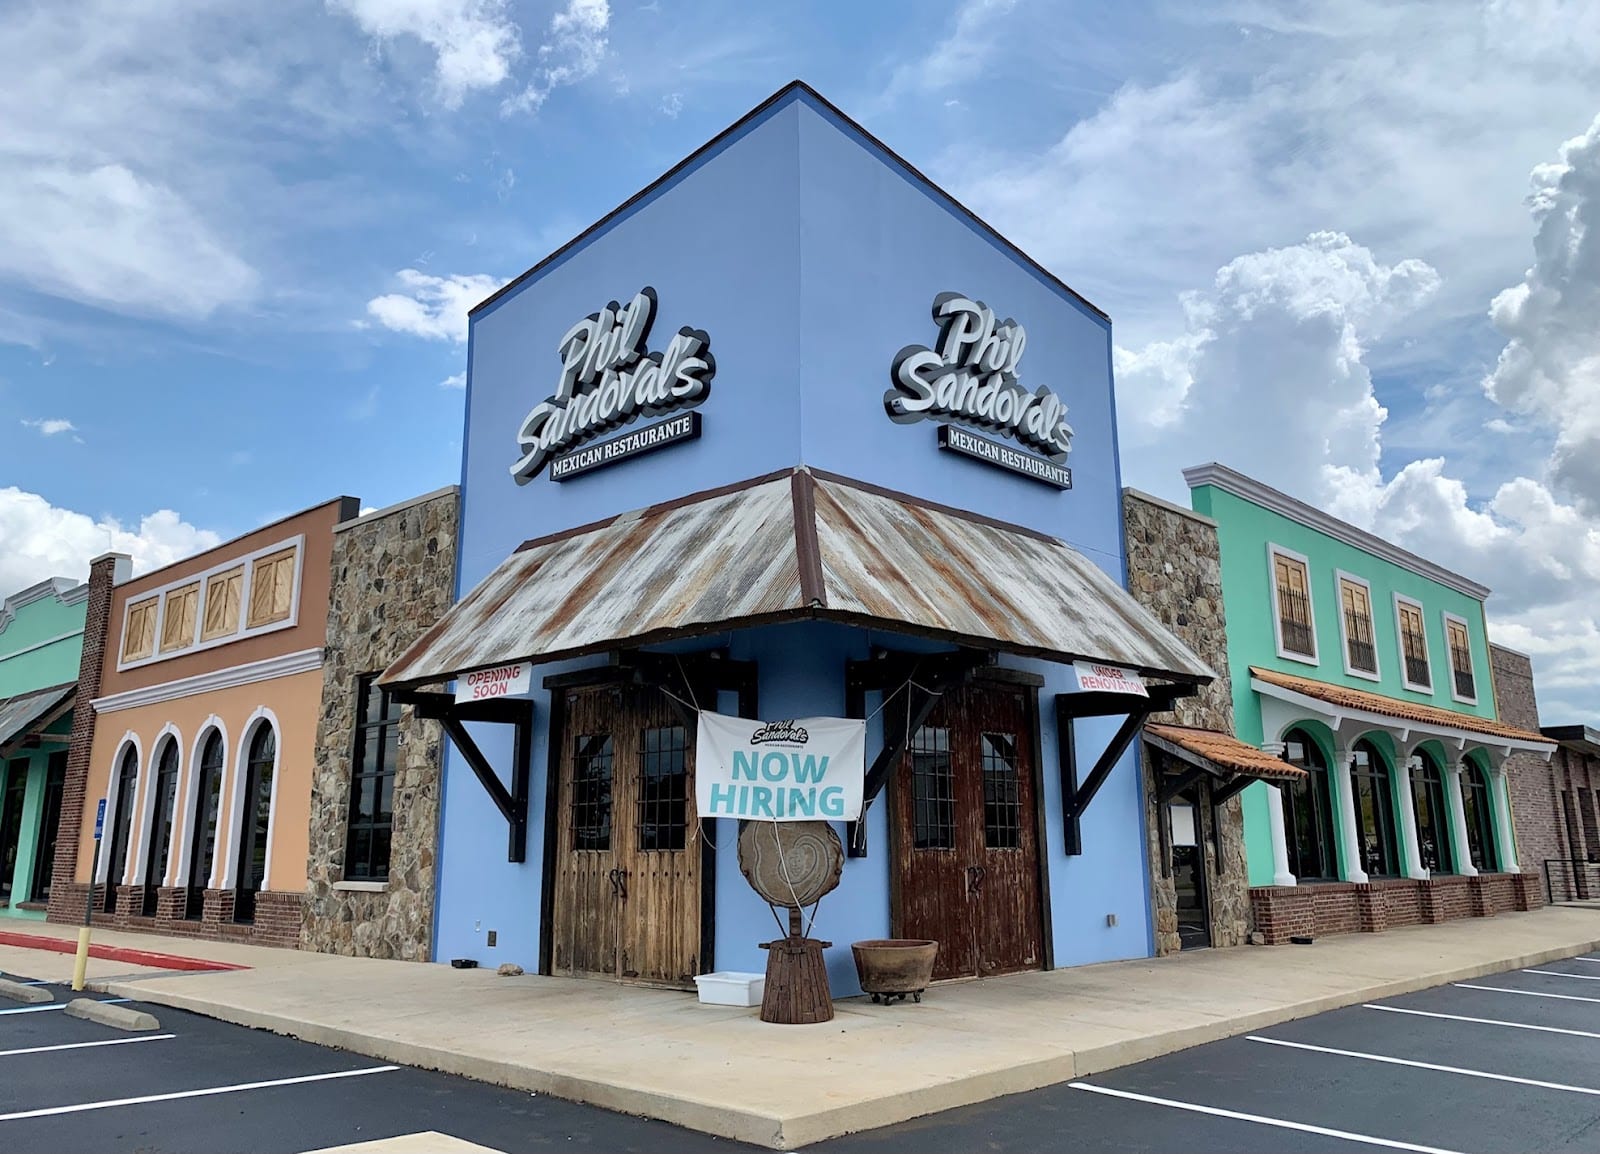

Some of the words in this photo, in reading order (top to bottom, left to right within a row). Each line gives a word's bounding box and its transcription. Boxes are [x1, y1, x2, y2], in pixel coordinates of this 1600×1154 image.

[557, 292, 652, 401] Phil
[938, 297, 1027, 379] Phil
[509, 332, 709, 476] Sandoval's
[895, 350, 1075, 453] Sandoval's
[552, 446, 602, 477] MEXICAN
[604, 416, 690, 457] RESTAURANTE
[950, 429, 999, 461] MEXICAN
[1001, 448, 1070, 485] RESTAURANTE
[467, 665, 521, 687] OPENING
[1081, 676, 1146, 694] RENOVATION
[1091, 664, 1126, 680] UNDER
[473, 681, 508, 699] SOON
[751, 727, 809, 745] Sandoval's
[731, 750, 830, 785] NOW
[709, 783, 845, 818] HIRING
